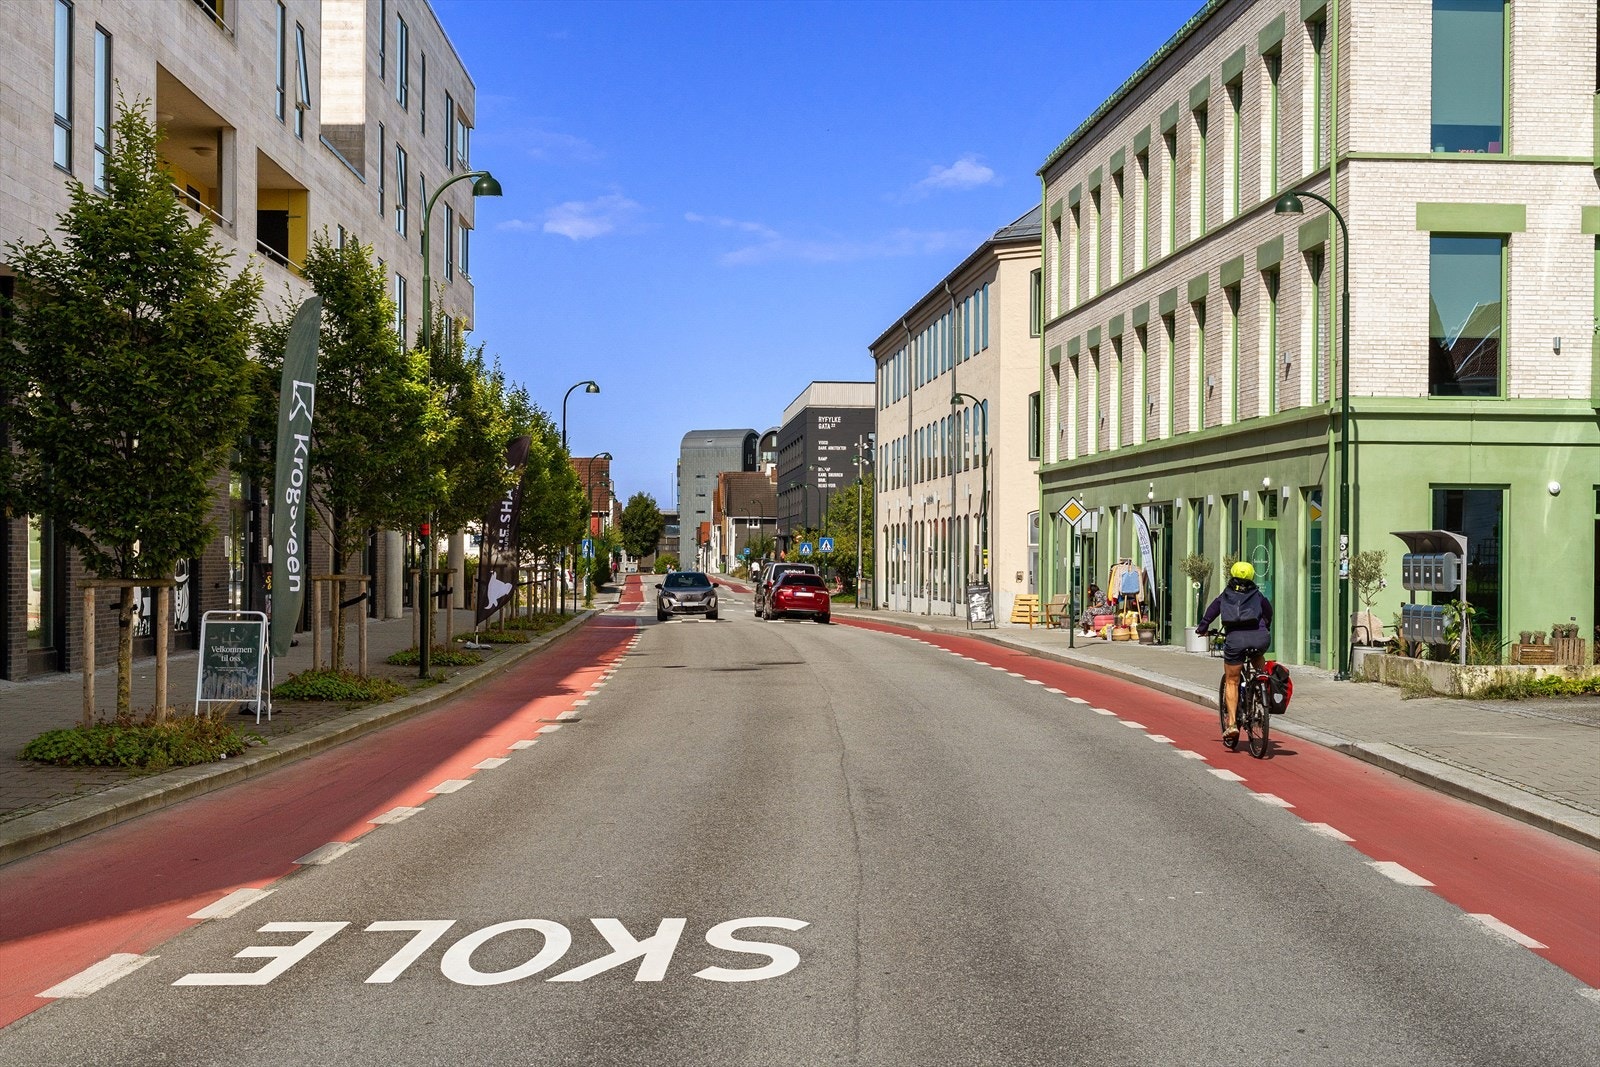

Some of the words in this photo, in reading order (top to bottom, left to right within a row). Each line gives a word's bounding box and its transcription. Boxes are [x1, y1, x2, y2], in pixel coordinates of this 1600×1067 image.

[286, 434, 309, 592] Krogsveen
[500, 465, 516, 523] SHAK
[171, 916, 811, 986] SKOLE
